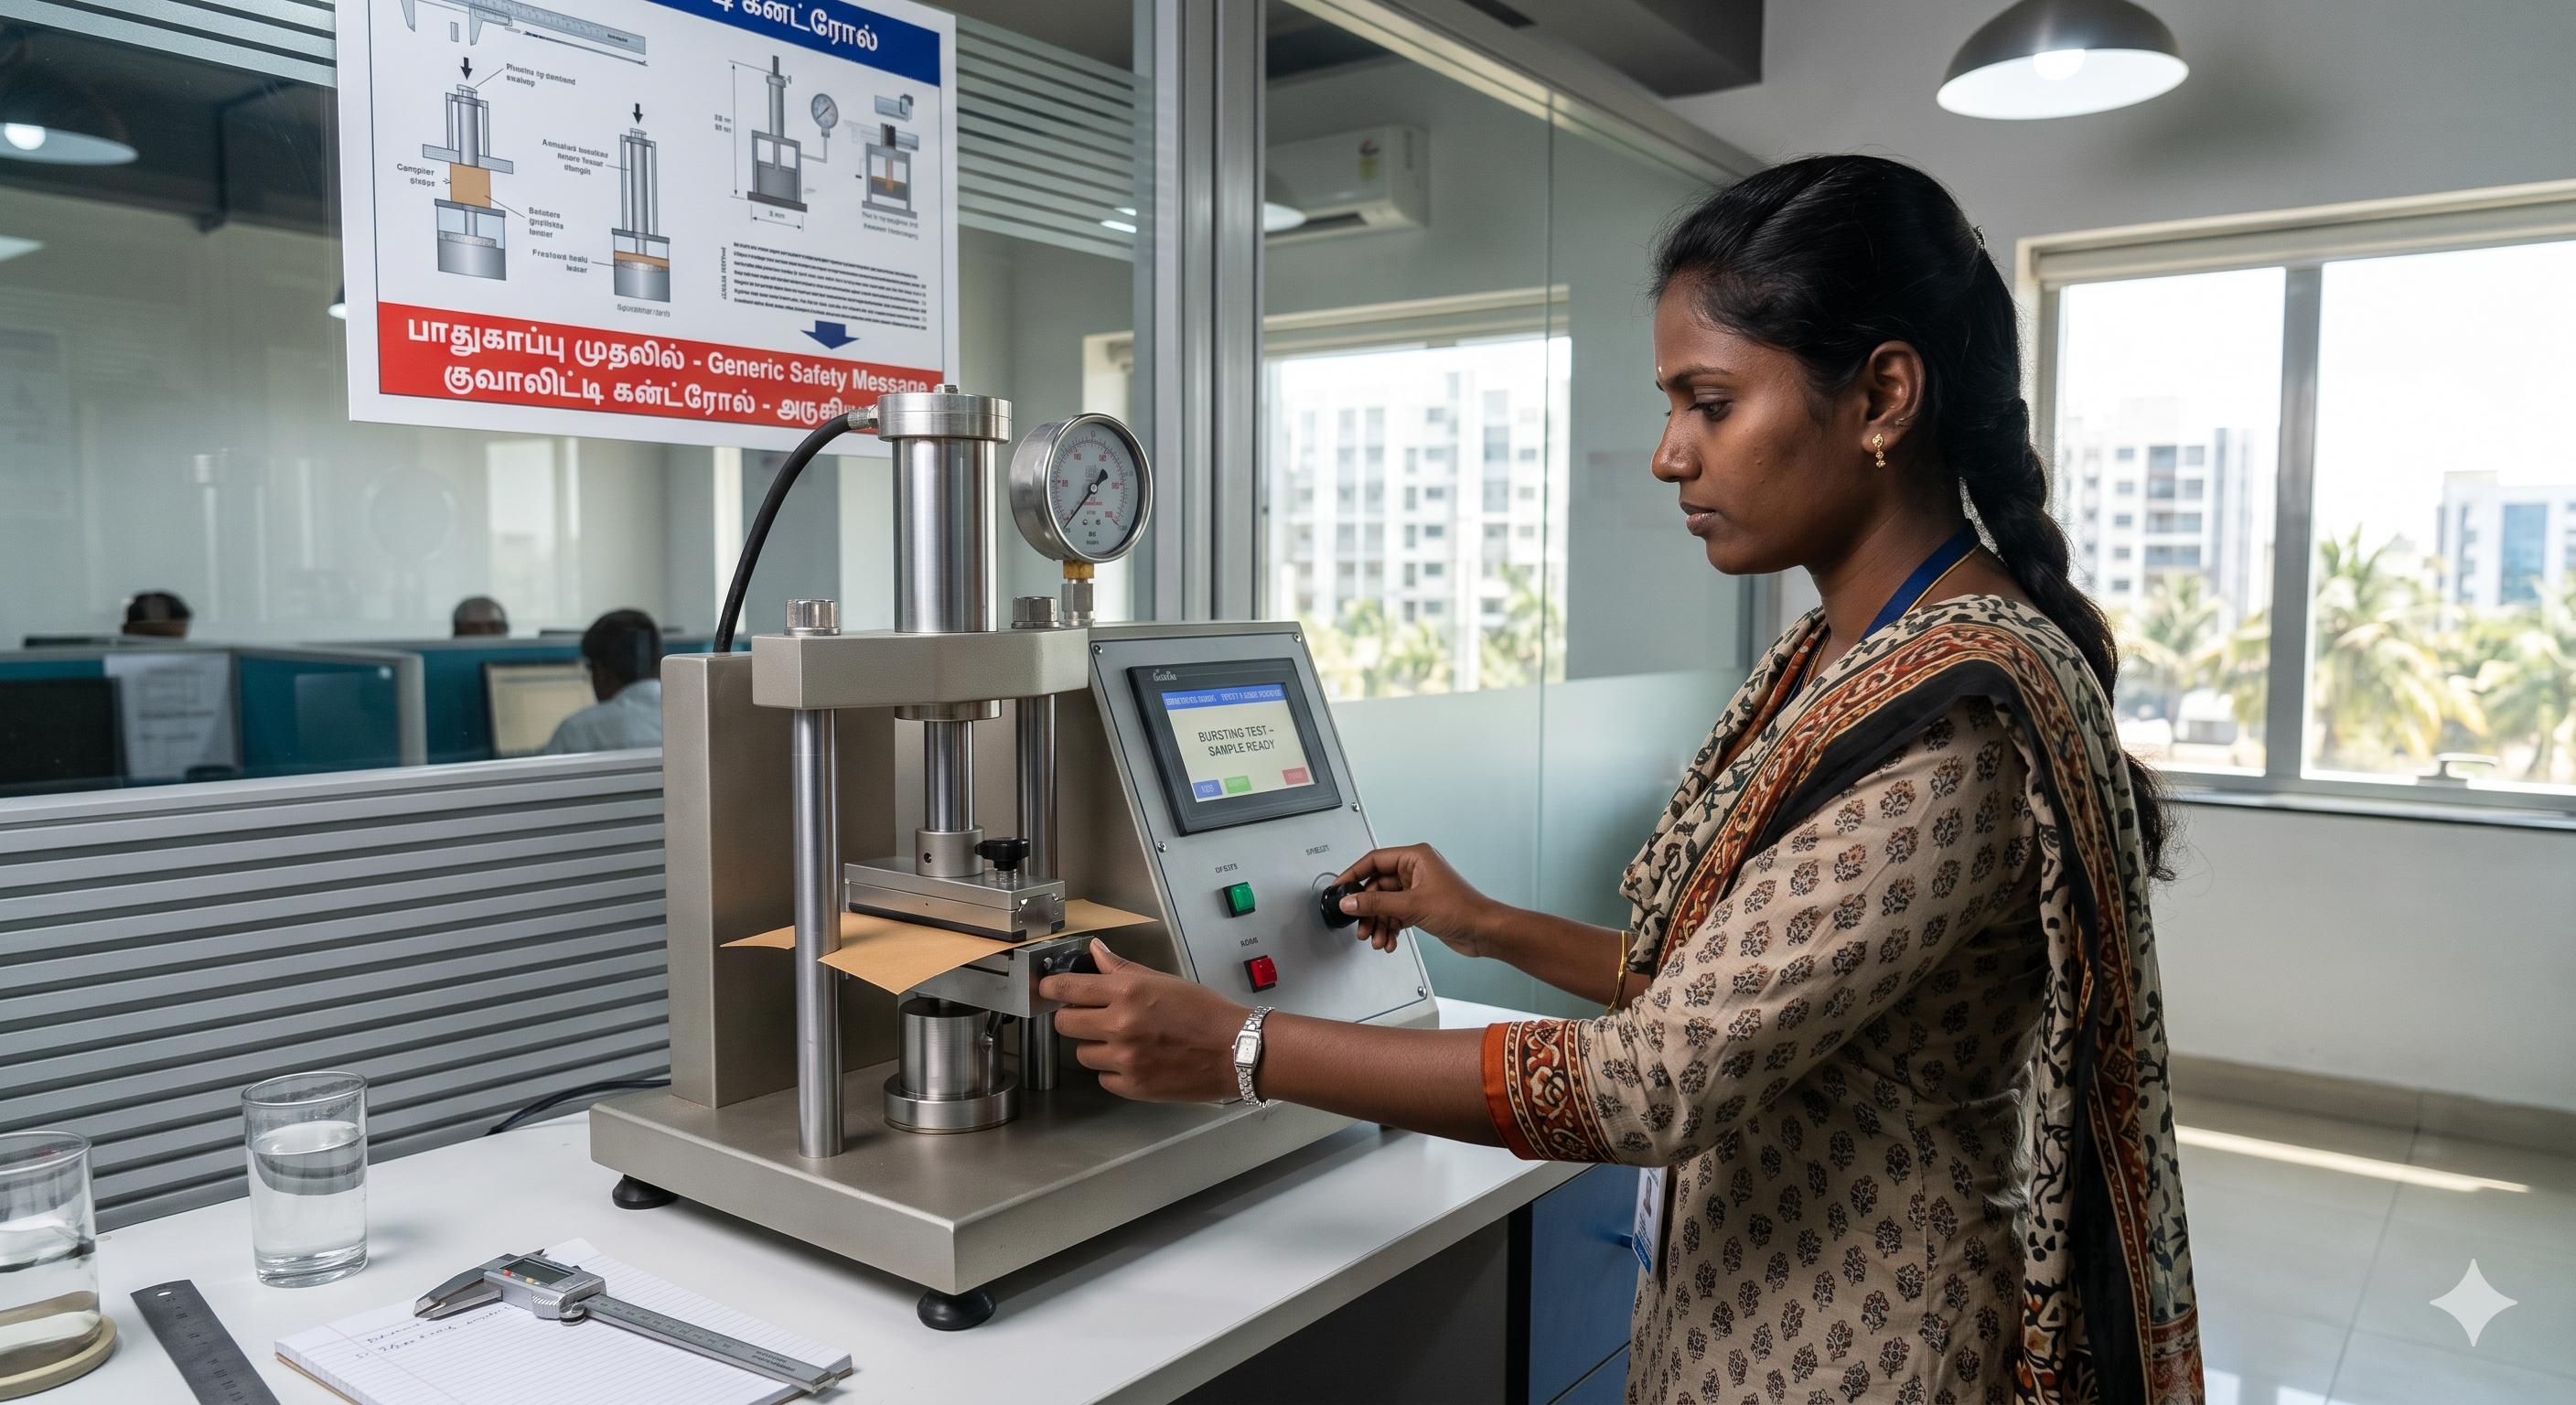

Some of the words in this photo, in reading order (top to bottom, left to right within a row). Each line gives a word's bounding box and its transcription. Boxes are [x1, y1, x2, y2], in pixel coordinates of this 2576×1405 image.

[408, 318, 564, 363] பாதுகாப்பு
[574, 339, 685, 370] முதலில்
[708, 351, 785, 381] Generic
[789, 361, 847, 393] Safety
[445, 365, 604, 405] குவாலிட்டி
[613, 379, 756, 415] கன்ட்ரோல்
[1198, 727, 1245, 743] BURSTING
[1245, 725, 1267, 737] TEST
[1208, 743, 1245, 756] SAMPLE
[1246, 739, 1275, 752] READY
